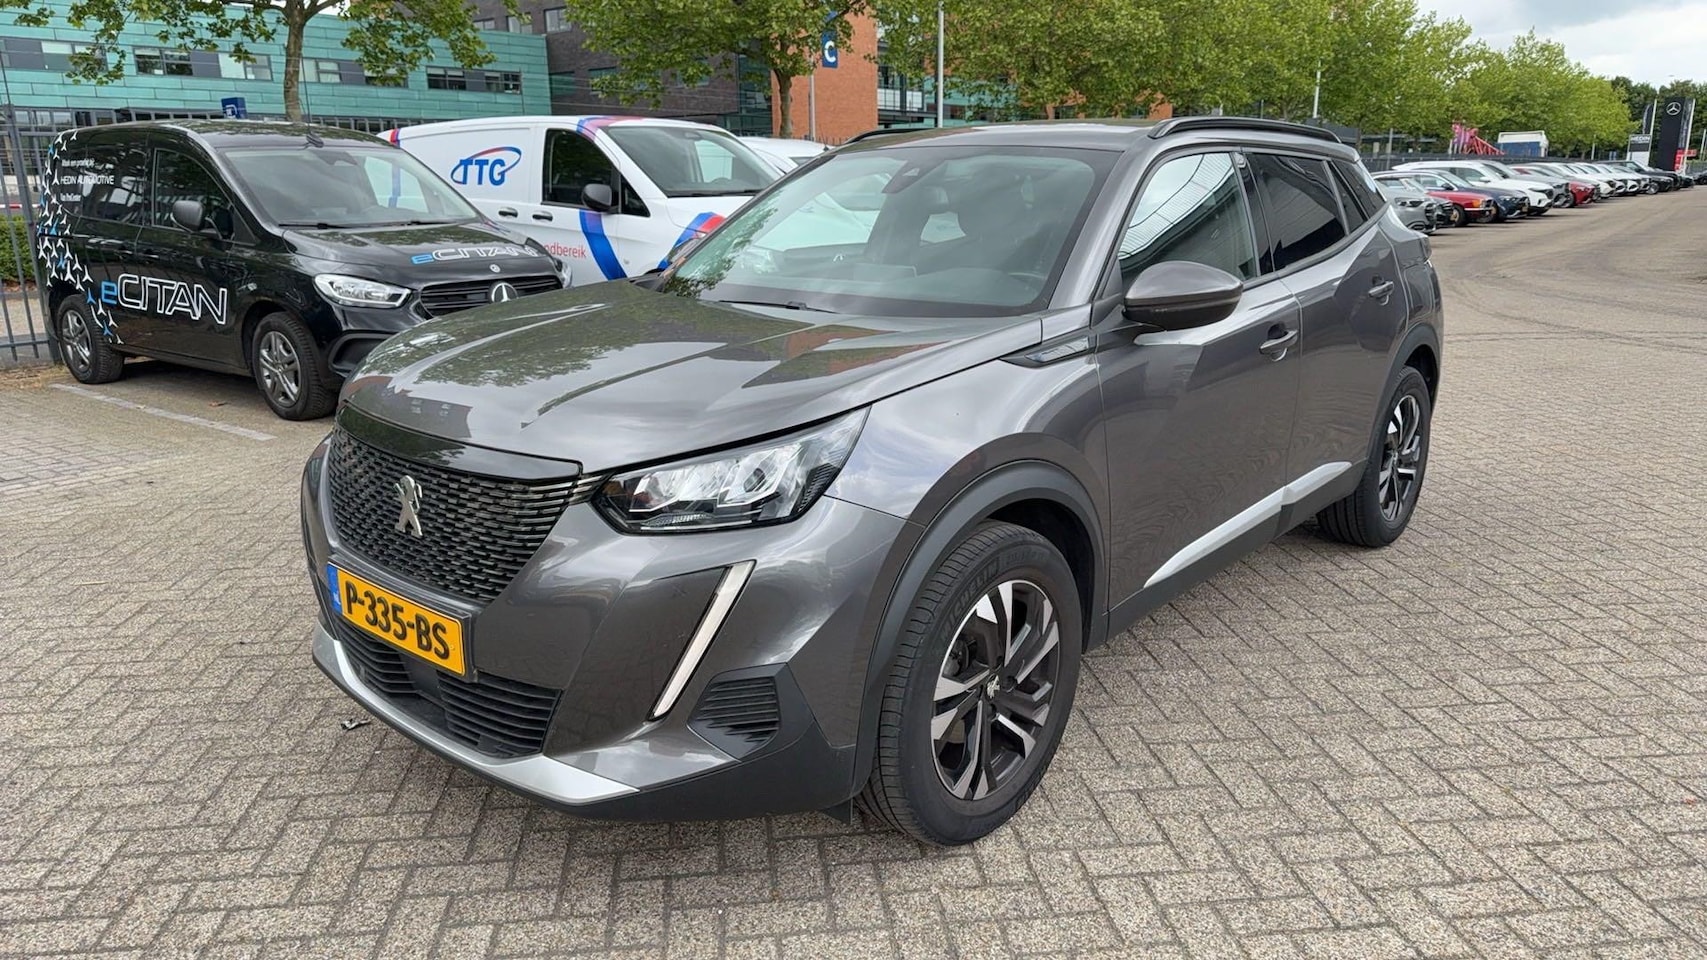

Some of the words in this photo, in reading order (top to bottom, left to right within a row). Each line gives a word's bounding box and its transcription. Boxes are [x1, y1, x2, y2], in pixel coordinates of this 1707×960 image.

[824, 40, 836, 62] C
[459, 158, 506, 186] TTG
[411, 246, 538, 265] eCITAN
[101, 273, 228, 325] eCITAN
[345, 580, 450, 660] P-335-BS
